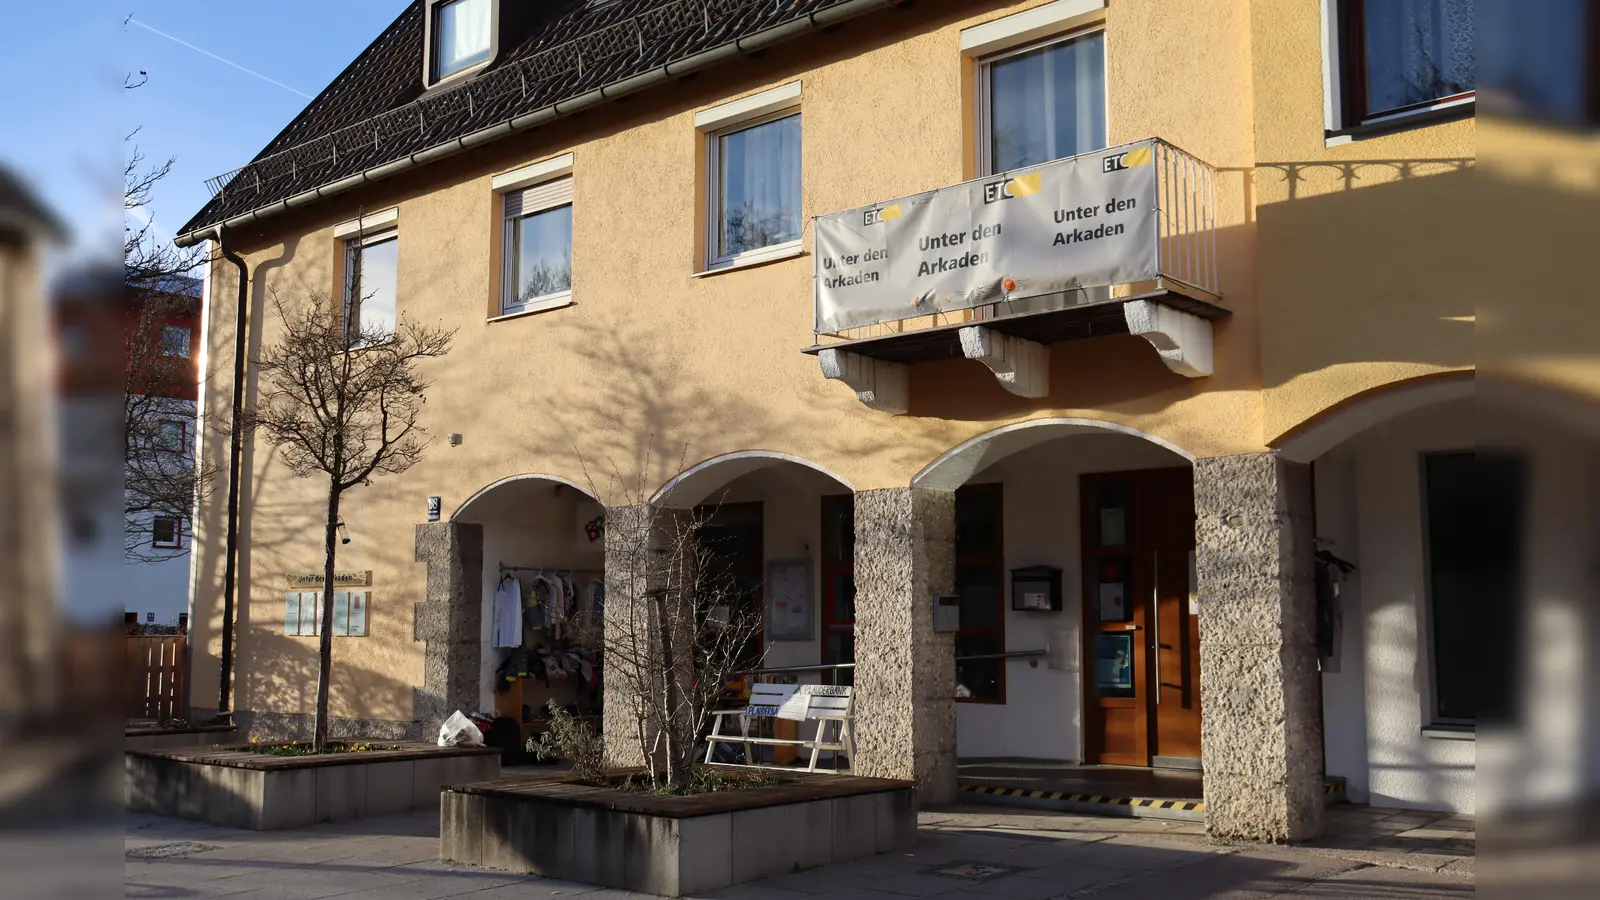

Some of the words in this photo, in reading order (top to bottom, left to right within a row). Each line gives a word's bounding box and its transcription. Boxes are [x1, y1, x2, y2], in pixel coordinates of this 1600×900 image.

[1103, 152, 1129, 172] ETC
[985, 179, 1014, 203] ETC
[1053, 204, 1100, 224] Unter
[1105, 197, 1136, 214] den
[918, 231, 967, 252] Unter
[971, 222, 1002, 241] den
[1052, 222, 1124, 247] Arkaden
[863, 248, 889, 262] den
[917, 250, 989, 277] Arkaden
[823, 271, 880, 289] Arkaden
[803, 685, 848, 696] PLAUDERBANK
[748, 705, 779, 716] PLAUDERBA
